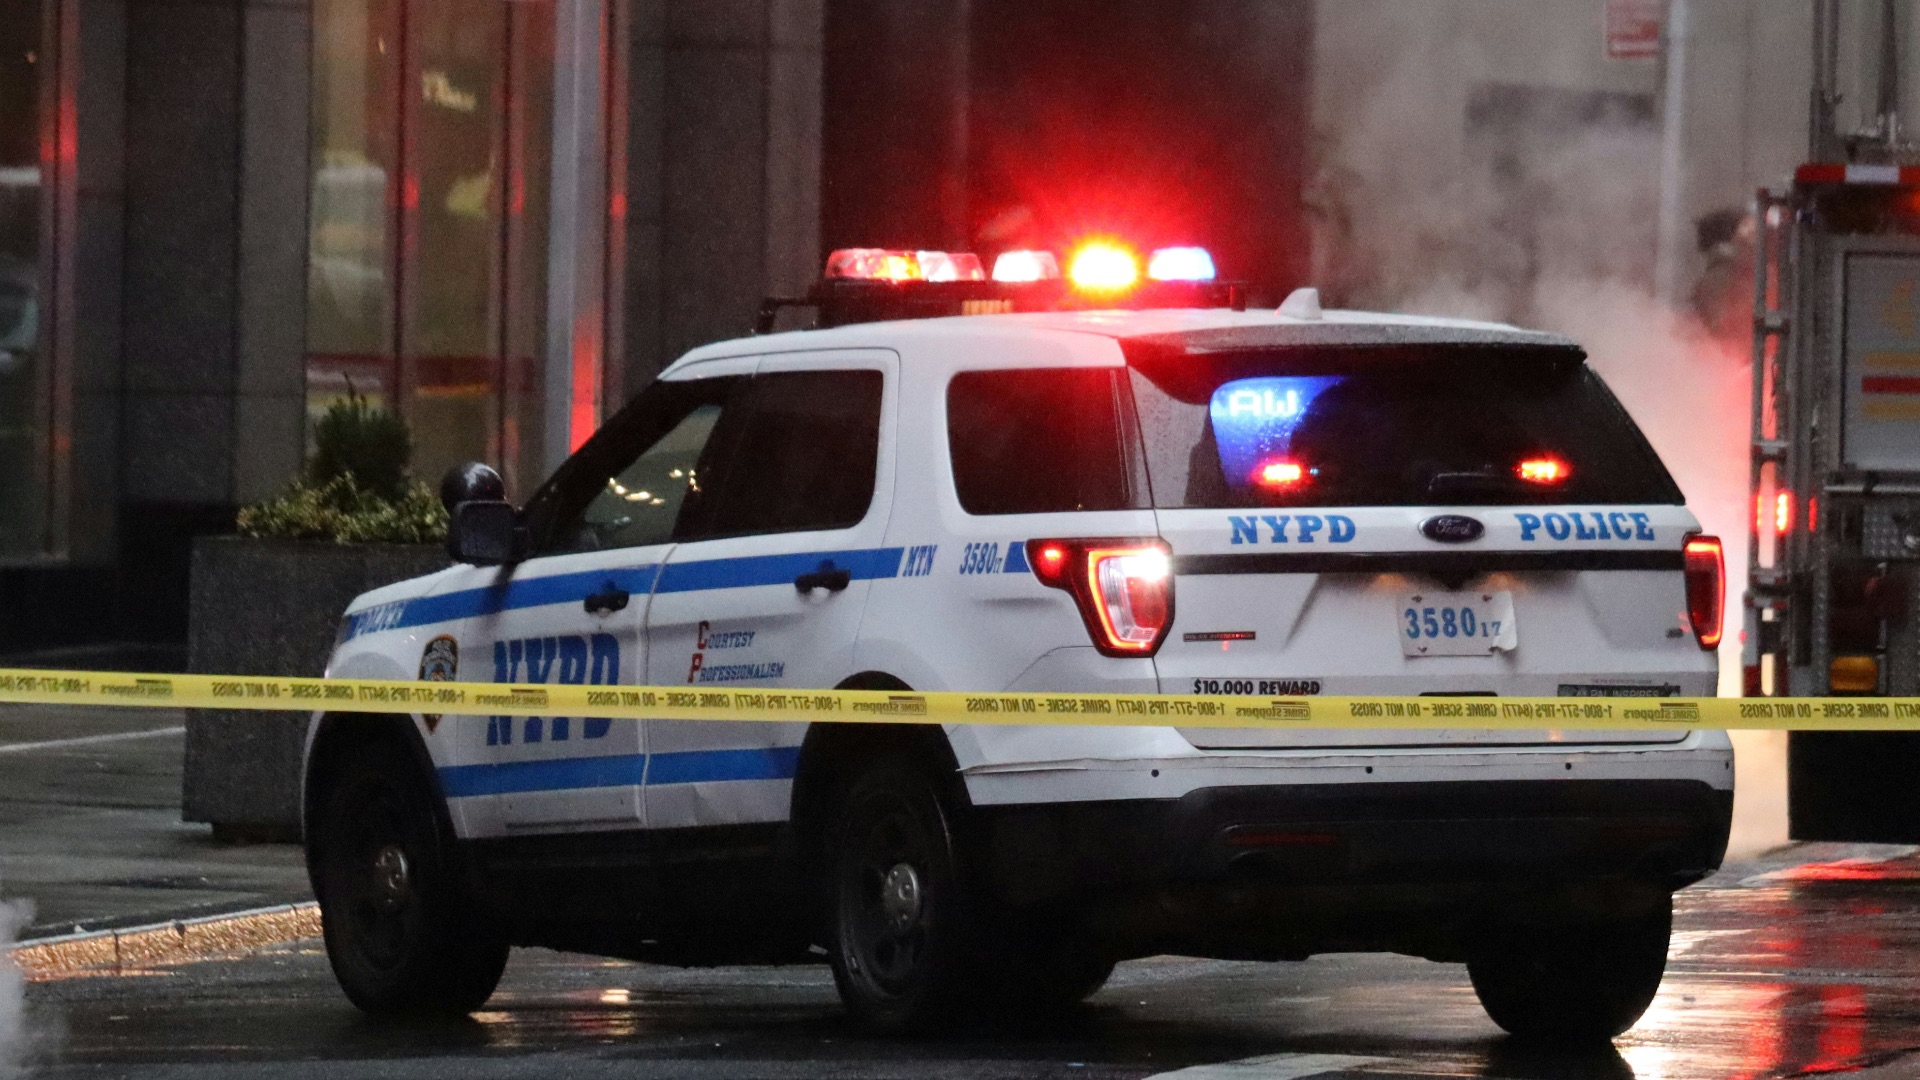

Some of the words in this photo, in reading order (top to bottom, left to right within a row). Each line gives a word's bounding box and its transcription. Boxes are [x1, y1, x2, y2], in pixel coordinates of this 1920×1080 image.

[1228, 514, 1356, 544] NYPD
[1514, 512, 1655, 541] POLICE
[902, 544, 938, 577] MTN
[959, 542, 998, 575] 3580
[1404, 607, 1476, 639] 3580
[487, 633, 620, 746] NYPD
[1193, 678, 1253, 695] $10,000
[1259, 681, 1320, 695] REWARD
